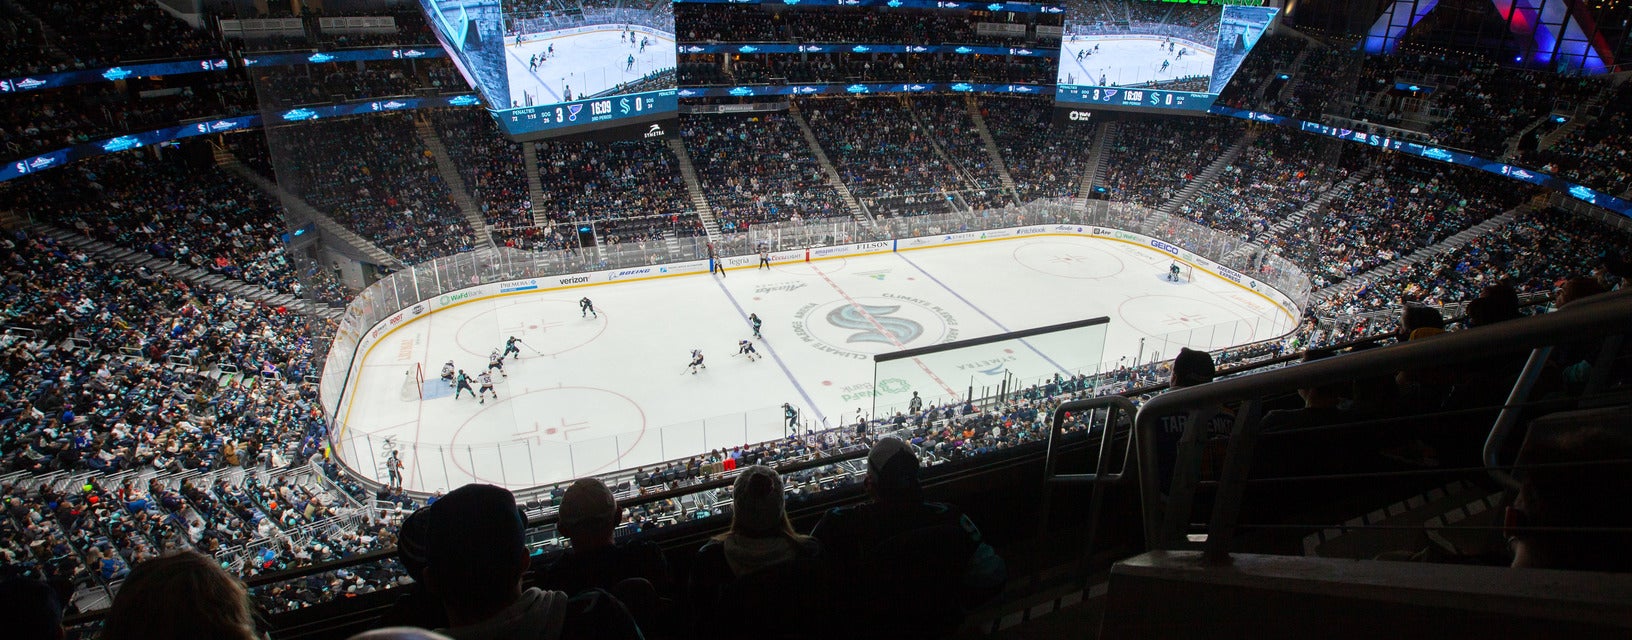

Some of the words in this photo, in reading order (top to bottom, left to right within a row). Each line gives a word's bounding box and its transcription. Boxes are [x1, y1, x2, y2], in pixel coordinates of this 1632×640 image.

[1093, 89, 1099, 100] 3
[1124, 90, 1142, 101] 16:09
[1165, 94, 1172, 105] 0
[590, 100, 611, 115] 16:09
[635, 97, 642, 111] 0
[556, 108, 563, 123] 3
[856, 242, 888, 250] FILSON
[1151, 240, 1178, 255] GEICO
[729, 257, 749, 266] Tegria
[1217, 265, 1241, 278] AMERICAN
[1219, 271, 1240, 283] EXPRESS
[501, 280, 528, 288] PREMERA
[560, 276, 589, 285] verizon
[451, 292, 468, 302] WaFd
[882, 292, 931, 307] CLIMATE
[792, 321, 812, 343] PLEDGE
[812, 342, 867, 360] CLIMATE
[956, 355, 1016, 370] SYMETRA
[840, 383, 873, 392] Bank
[841, 390, 882, 402] WaFd
